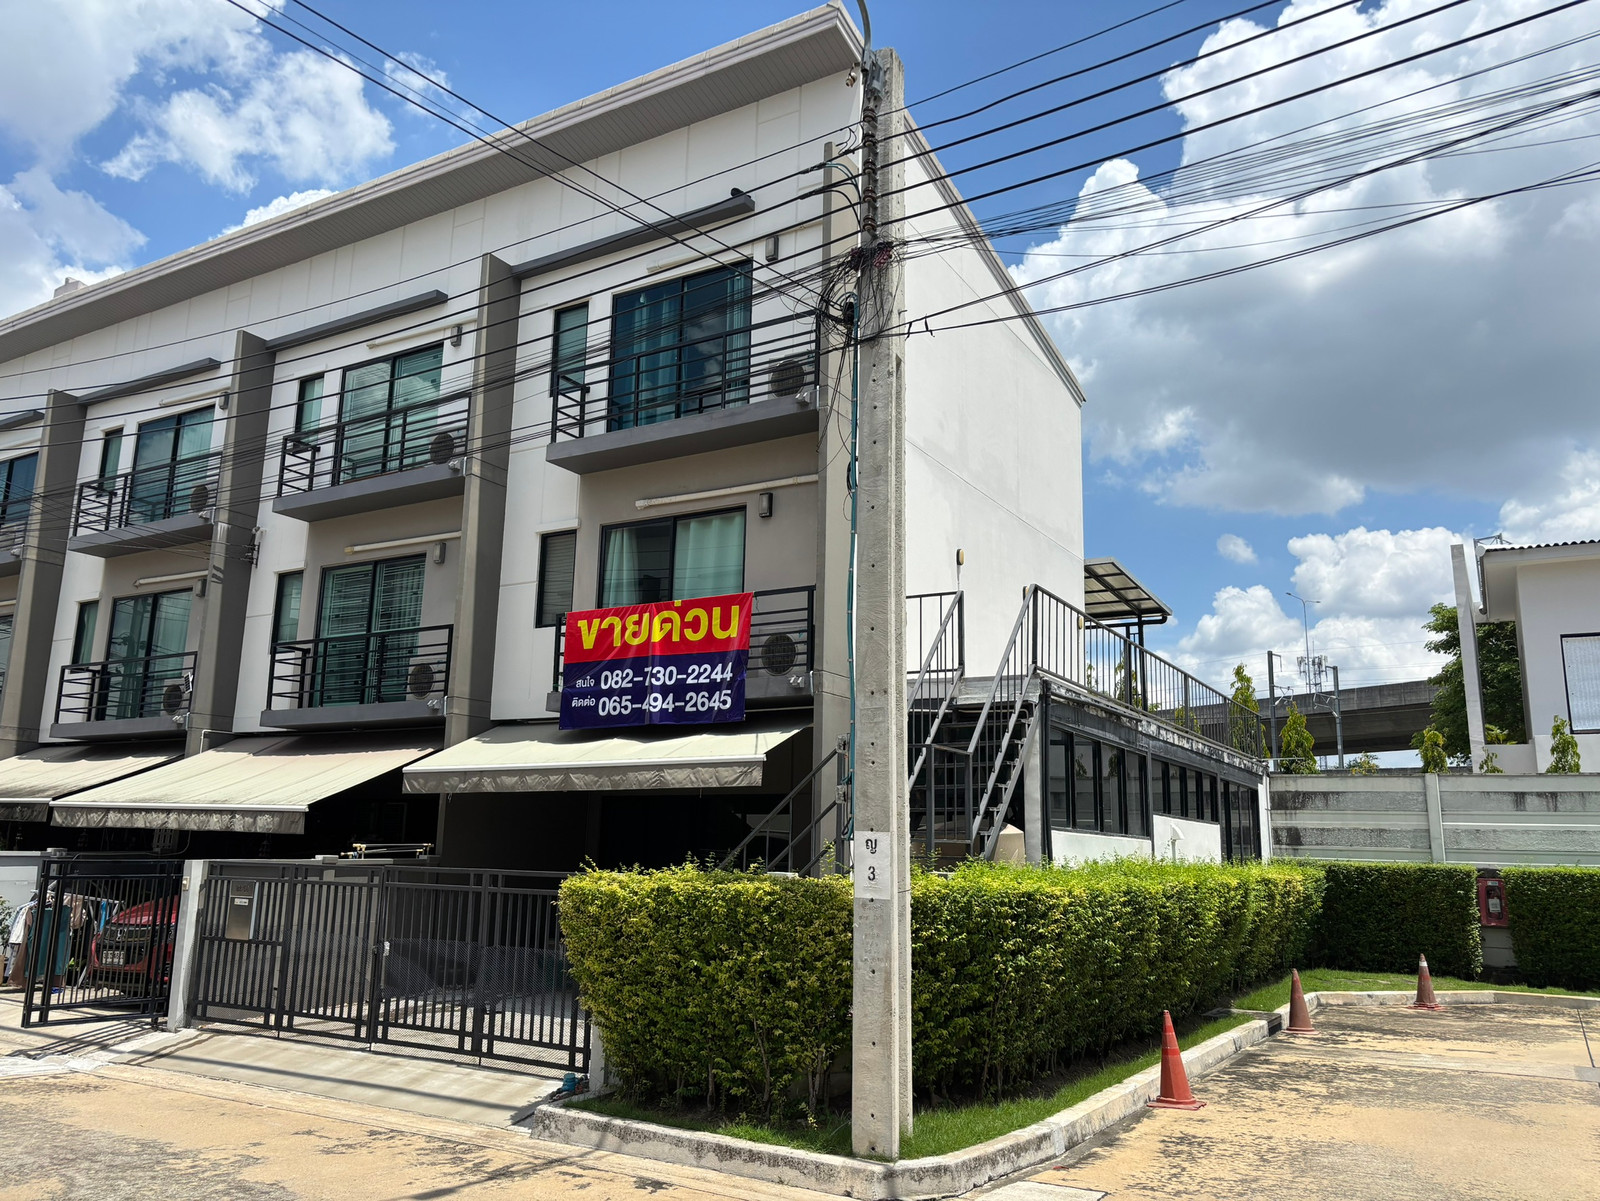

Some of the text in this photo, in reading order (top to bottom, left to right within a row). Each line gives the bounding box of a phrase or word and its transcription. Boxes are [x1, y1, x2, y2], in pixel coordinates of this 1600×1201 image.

[577, 600, 740, 650] ขายด่วน
[575, 662, 733, 690] สนใจ 082-730-2244
[571, 689, 732, 716] ติดต่อ 065-494-2645
[865, 838, 877, 854] ญ
[868, 866, 876, 881] 3
